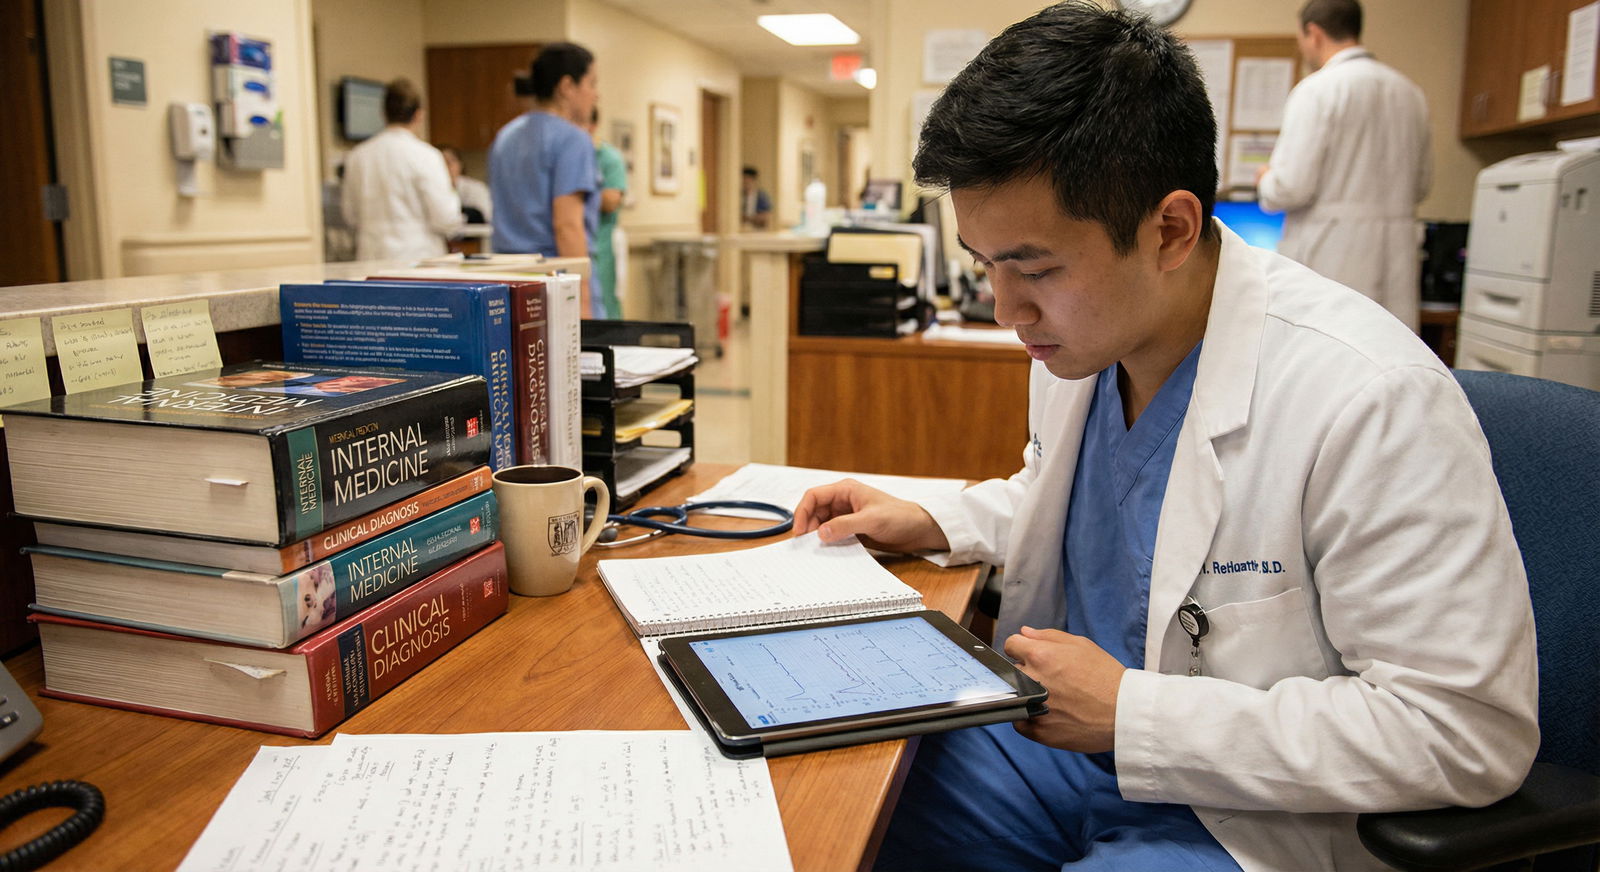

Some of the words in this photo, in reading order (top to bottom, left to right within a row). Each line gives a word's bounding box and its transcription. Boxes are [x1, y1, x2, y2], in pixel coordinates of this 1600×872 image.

[107, 390, 292, 416] INTERNAL
[143, 387, 323, 408] MEDICINE
[331, 422, 428, 476] INTERNAL
[297, 454, 310, 515] INTERNAL
[307, 452, 318, 510] MEDICINE
[334, 449, 429, 507] MEDICINE
[323, 527, 369, 551] CLINICAL
[370, 503, 420, 532] DIAGNOSIS
[347, 537, 418, 583] INTERNAL
[350, 555, 419, 603] MEDICINE
[371, 593, 450, 655] CLINICAL
[373, 617, 451, 681] DIAGNOSIS
